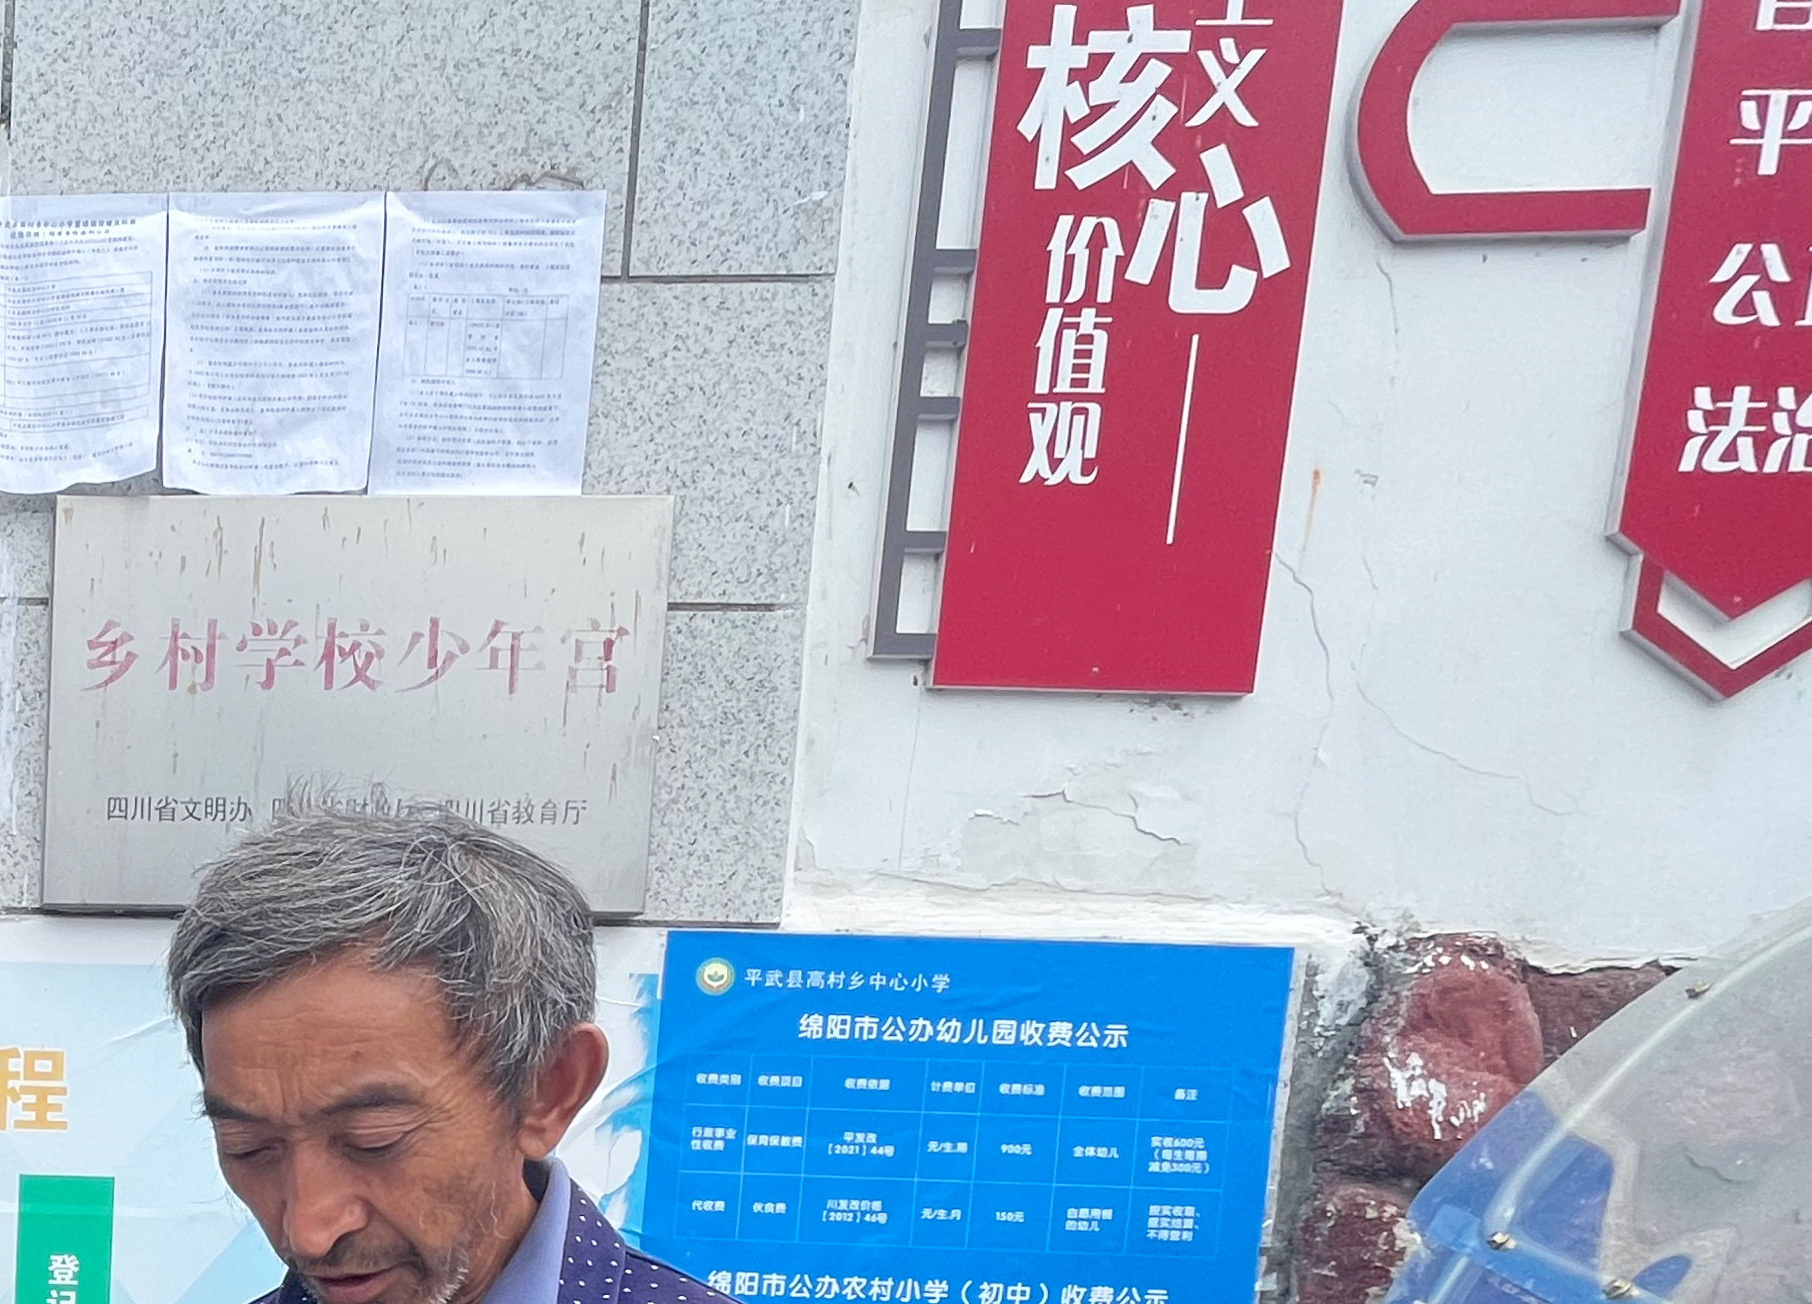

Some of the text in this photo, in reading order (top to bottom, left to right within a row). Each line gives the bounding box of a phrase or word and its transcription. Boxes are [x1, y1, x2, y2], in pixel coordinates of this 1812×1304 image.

[1729, 88, 1812, 175] 平
[1708, 242, 1812, 326] 公
[1019, 214, 1125, 487] 价值观
[81, 615, 631, 695] 乡村学校少年宫
[105, 795, 254, 823] 四川省文明办
[744, 967, 952, 994] 平武县高村乡中心小学
[798, 1012, 1130, 1050] 绵阳市公办幼儿园收费公示
[1000, 1143, 1033, 1156] 900元
[995, 1210, 1026, 1223] 150元
